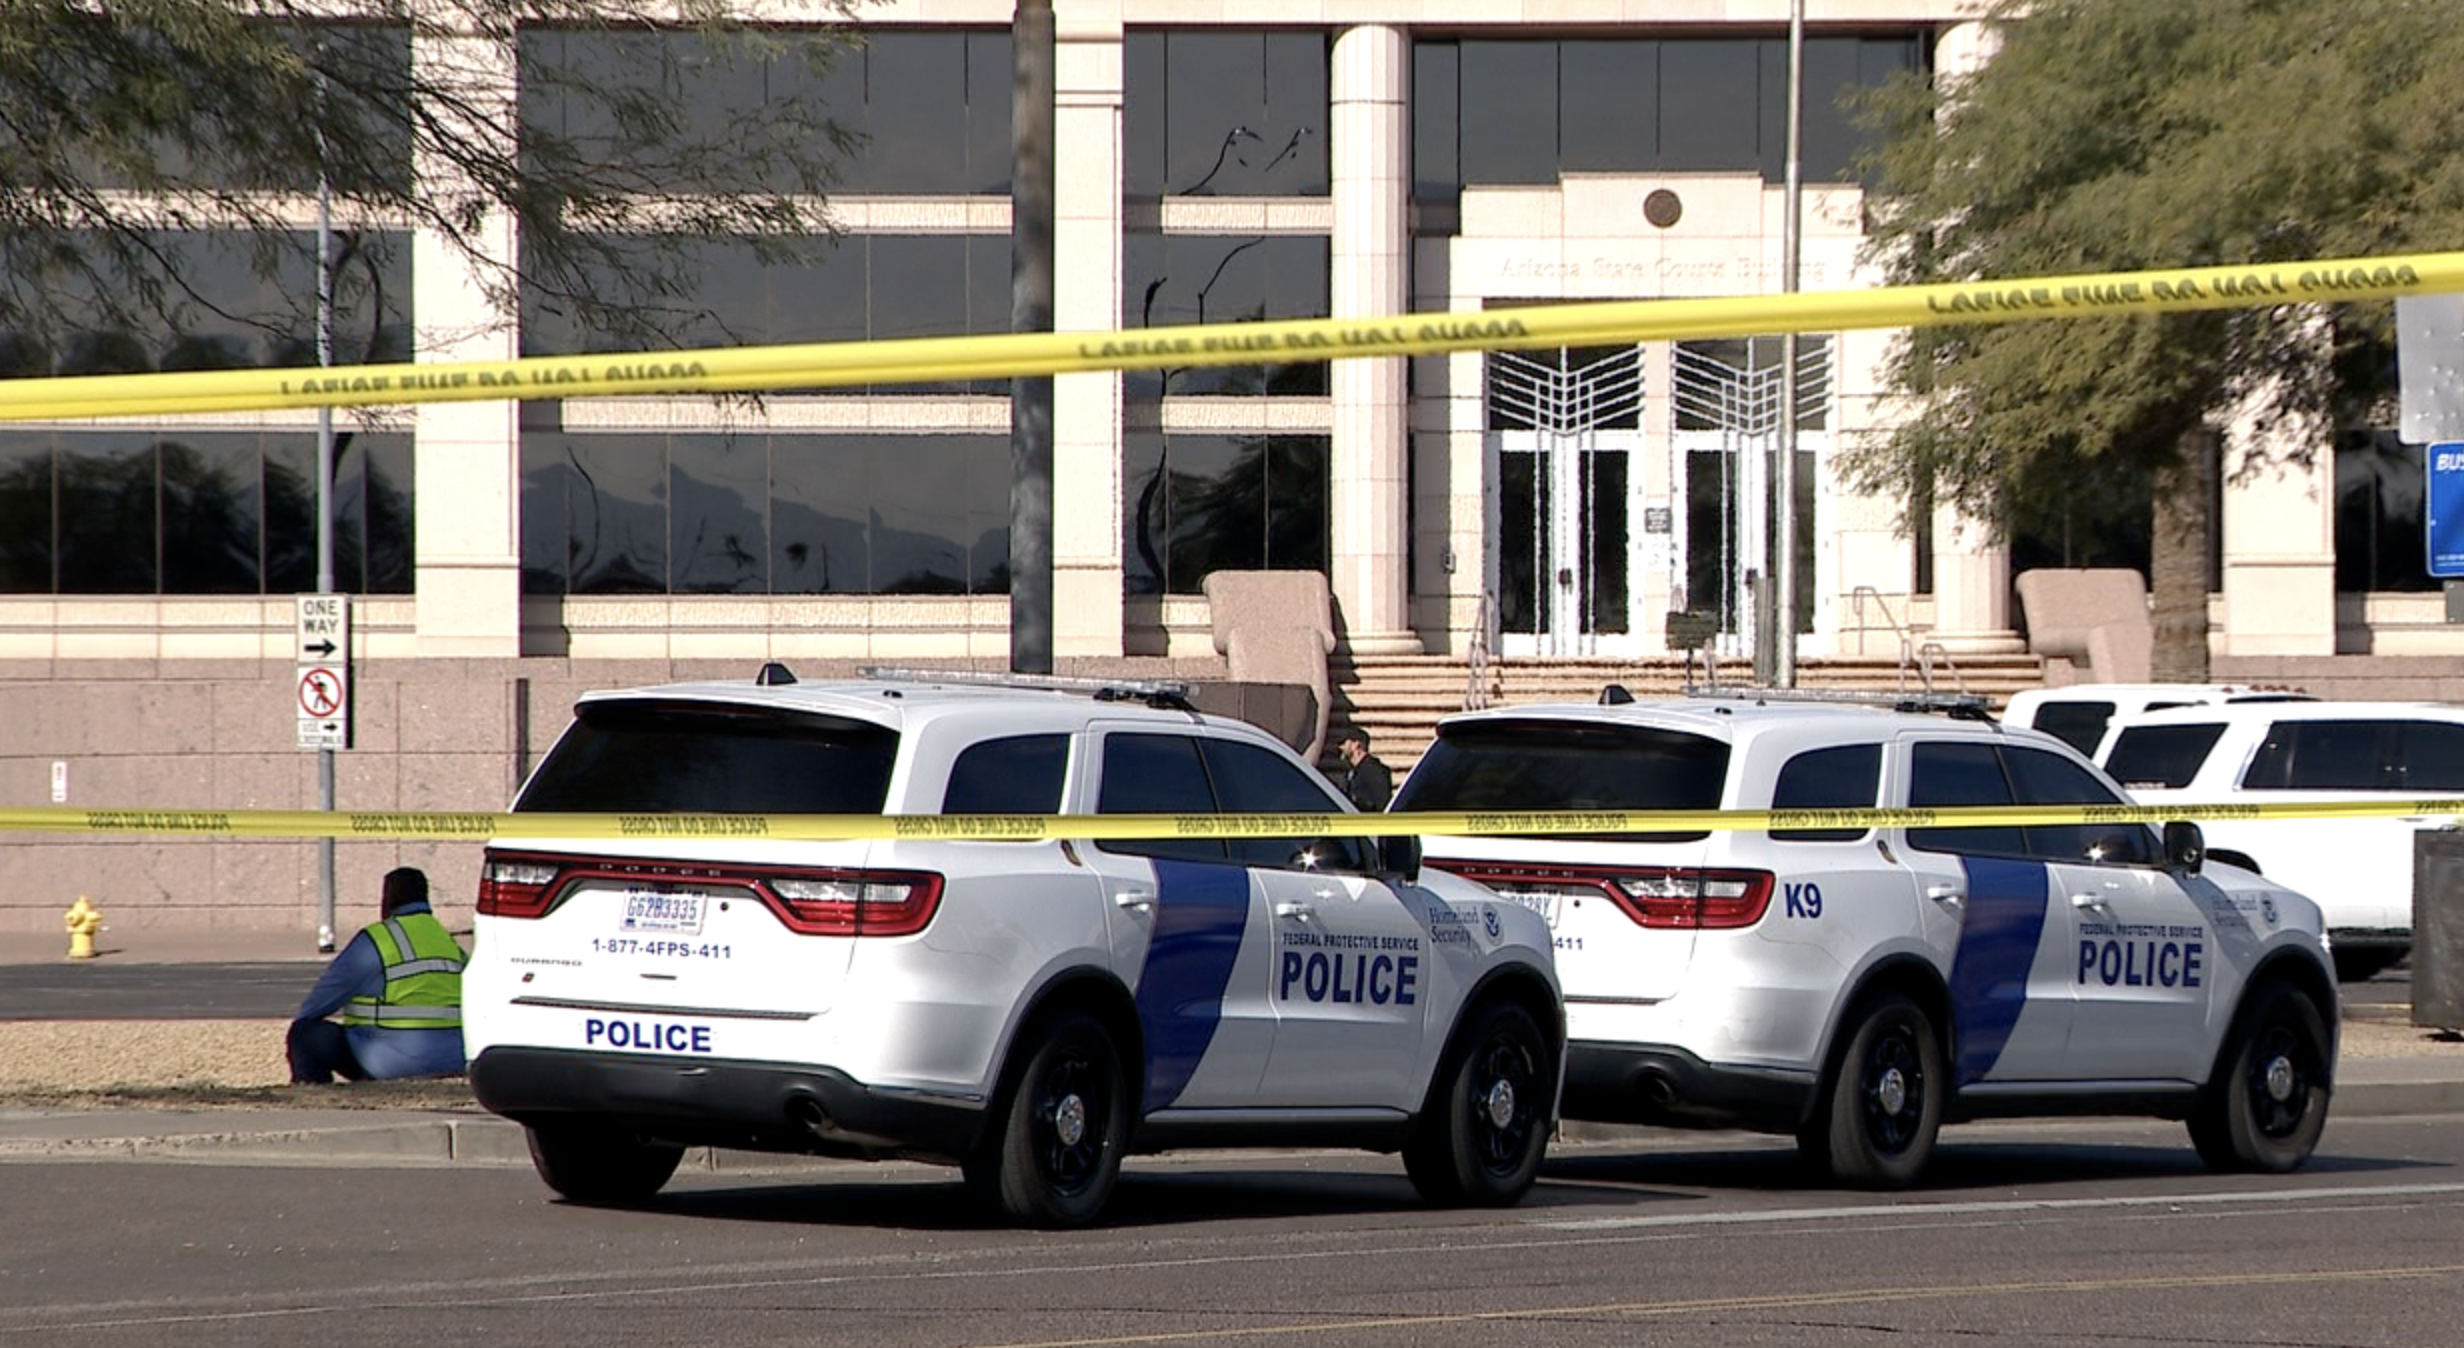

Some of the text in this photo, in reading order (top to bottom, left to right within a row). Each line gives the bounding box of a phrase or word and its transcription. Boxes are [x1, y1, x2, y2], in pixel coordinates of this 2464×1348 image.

[1737, 257, 1826, 282] Builng
[303, 599, 338, 616] ONE
[303, 618, 338, 634] WAY
[1784, 882, 1822, 919] K9
[1429, 906, 1479, 925] Homeland
[1283, 932, 1420, 951] FEDERAL PROTECTIVE SERVICE
[1431, 925, 1472, 946] Security
[592, 938, 731, 959] 1-877-4FPS-411
[2078, 940, 2203, 987] POLICE
[1281, 951, 1419, 1005] POLICE
[586, 1018, 712, 1053] POLICE
